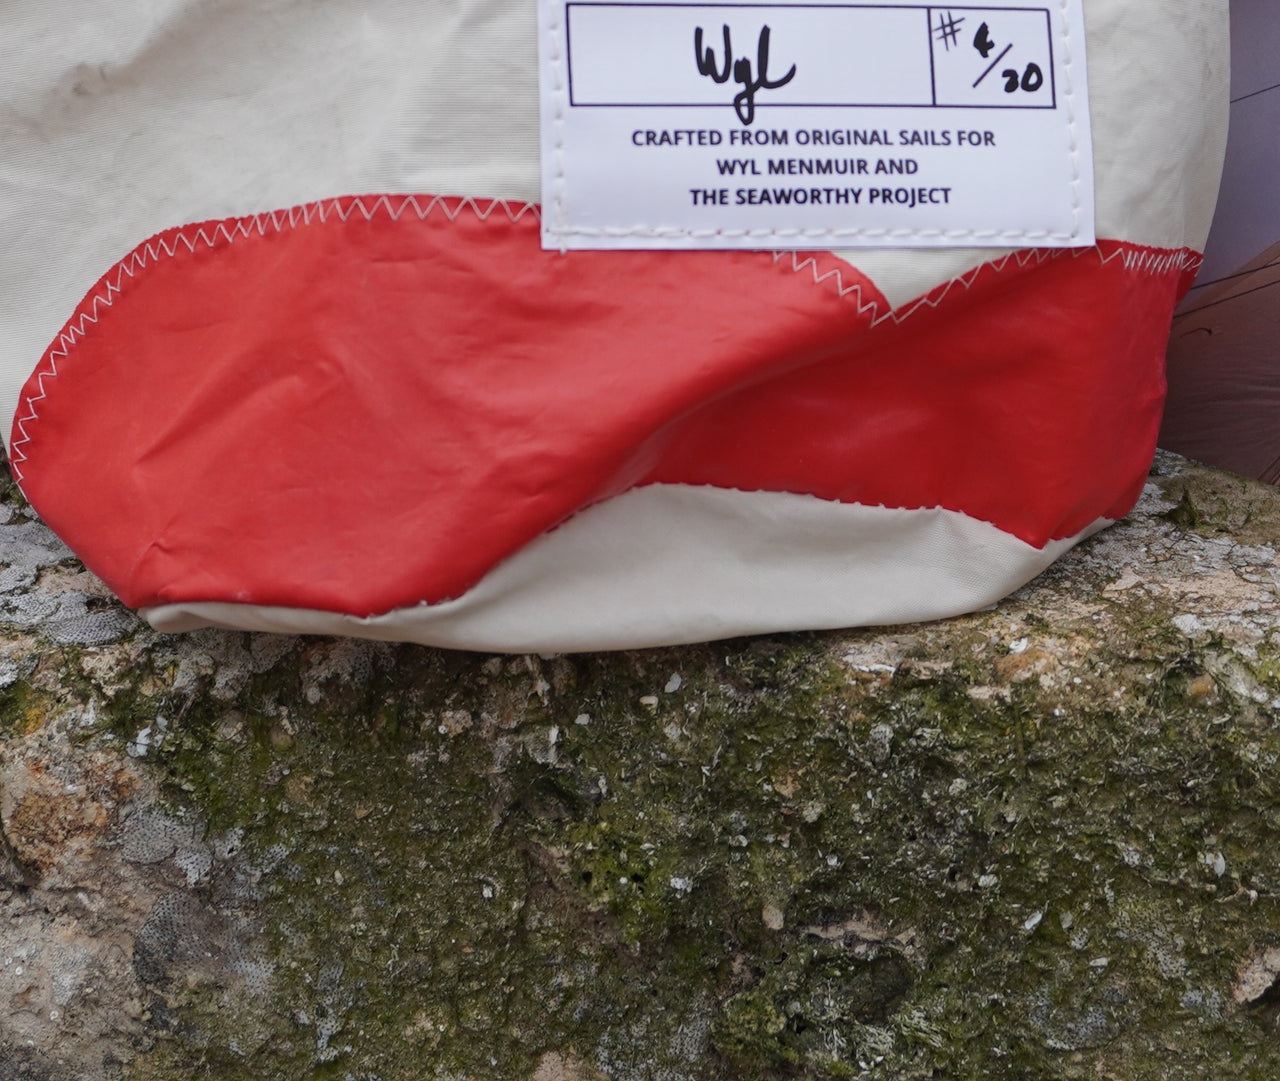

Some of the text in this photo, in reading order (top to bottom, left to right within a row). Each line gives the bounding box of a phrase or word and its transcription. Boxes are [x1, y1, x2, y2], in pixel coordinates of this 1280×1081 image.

[694, 24, 796, 126] Wyl
[631, 129, 996, 147] CRAFTED FROM ORIGINAL SAILS FOR
[716, 158, 919, 176] WYL MENMUIR AND
[689, 187, 952, 209] THE SEAWORTHY PROJECT
